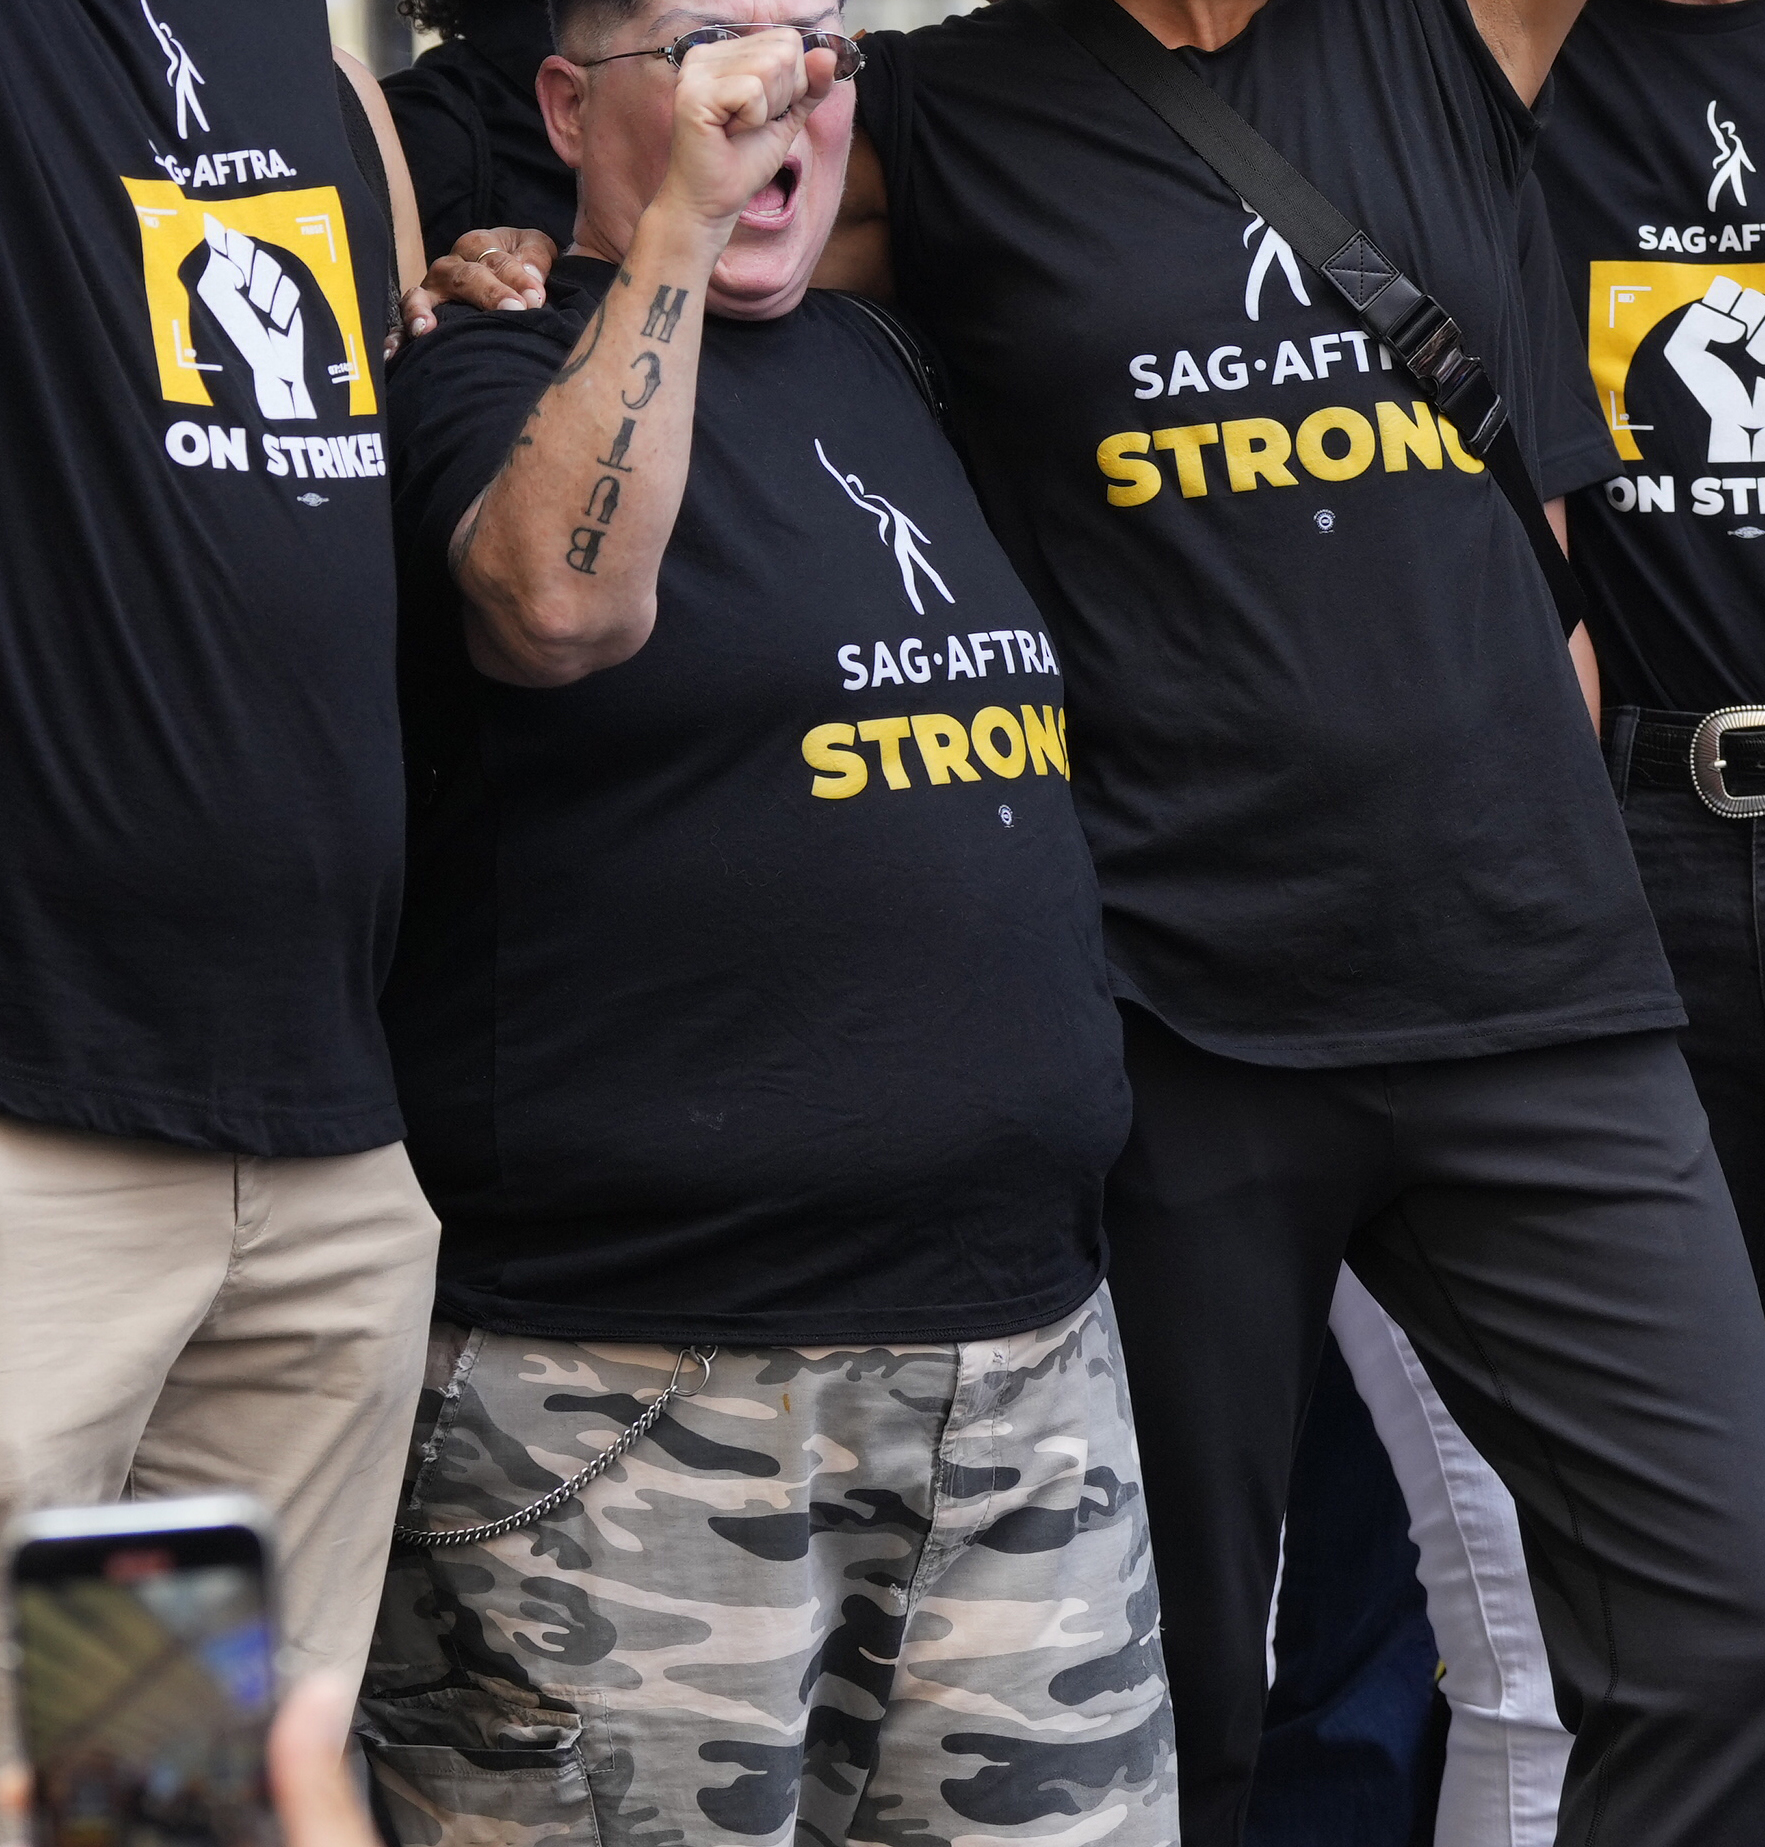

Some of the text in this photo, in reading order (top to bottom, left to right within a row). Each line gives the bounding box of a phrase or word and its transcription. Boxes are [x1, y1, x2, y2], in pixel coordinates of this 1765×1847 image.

[1129, 330, 1393, 400] SAG·AFT
[165, 420, 386, 478] ON STRIKE!
[566, 284, 689, 575] BUTCH
[1604, 475, 1675, 513] ON
